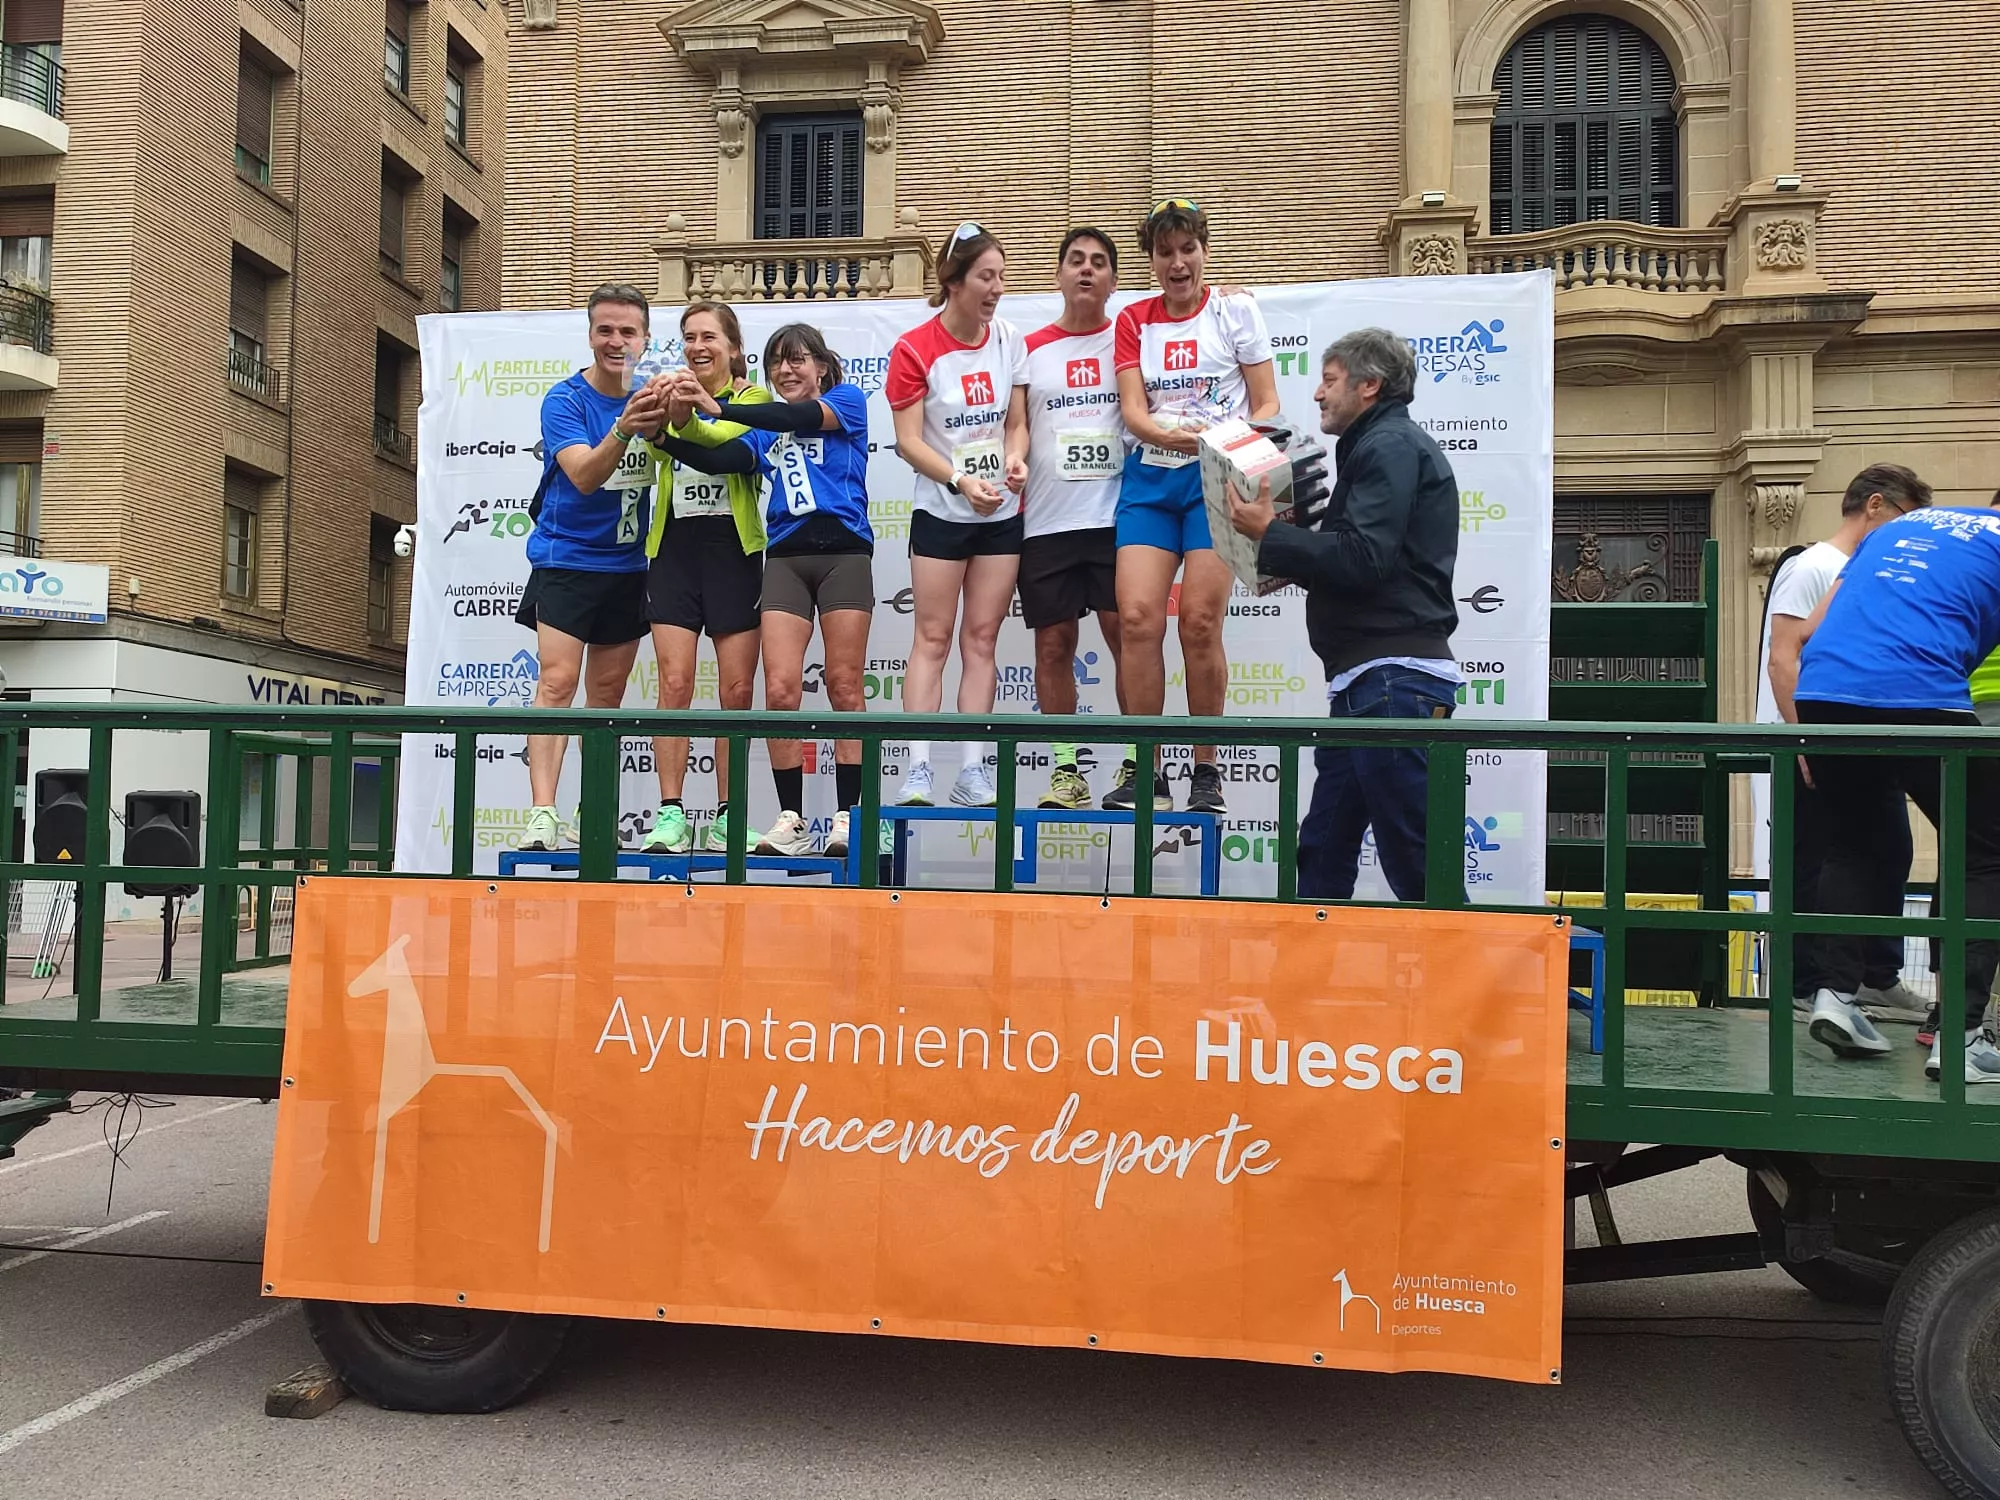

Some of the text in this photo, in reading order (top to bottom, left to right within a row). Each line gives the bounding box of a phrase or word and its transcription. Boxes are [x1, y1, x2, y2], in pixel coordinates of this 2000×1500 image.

[494, 360, 571, 375] FARTLECK
[1417, 353, 1486, 372] RESAS
[1419, 416, 1508, 431] ntamiento
[446, 441, 516, 459] iberCaja
[1438, 438, 1478, 451] esca
[1067, 445, 1110, 463] 539
[621, 468, 645, 477] DANIEL
[964, 453, 1000, 475] 540
[1063, 462, 1117, 471] GIL MANUEL
[980, 472, 996, 480] EVA
[684, 484, 724, 501] 507
[697, 499, 716, 507] ANA
[444, 581, 524, 597] Automóvile
[453, 599, 519, 617] CABRE
[441, 663, 528, 679] CARRERA
[1230, 663, 1284, 680] TLECK
[247, 674, 310, 704] VITAL
[438, 681, 531, 697] EMPRESAS
[1162, 762, 1280, 783] CARERO
[475, 808, 531, 825] FARTLE
[594, 995, 1463, 1094] Ayuntamiento de Huesca
[743, 1083, 1282, 1210] Hacemos deporte
[1392, 1272, 1517, 1297] Ayuntamiento
[1393, 1293, 1485, 1315] de Huesca
[1391, 1324, 1442, 1336] Deportes
